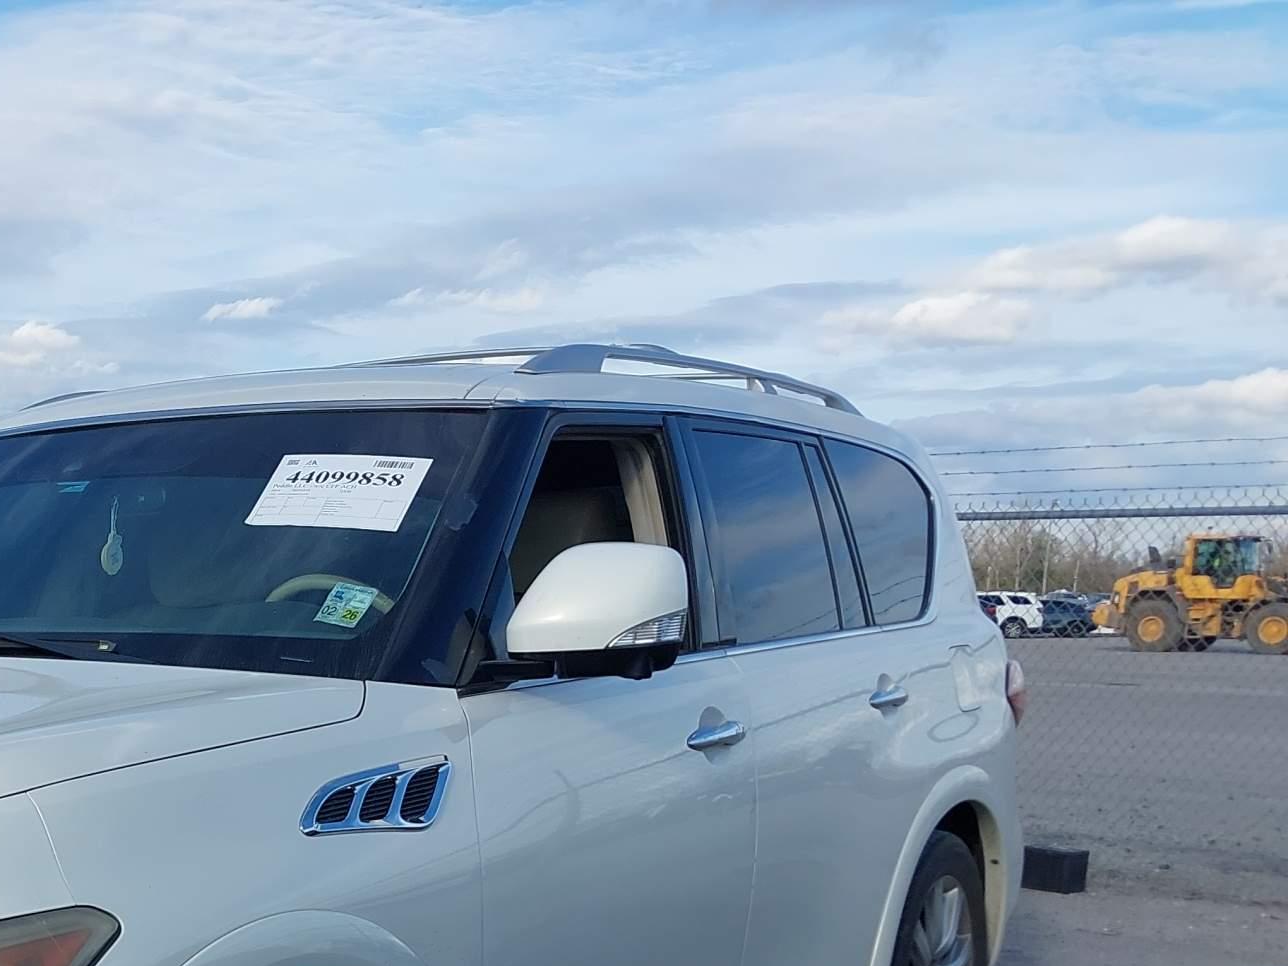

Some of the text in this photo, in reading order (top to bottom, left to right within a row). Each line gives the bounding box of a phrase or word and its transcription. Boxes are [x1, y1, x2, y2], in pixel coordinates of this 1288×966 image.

[286, 471, 405, 487] 44099858
[321, 606, 337, 616] 02
[341, 610, 359, 620] 26
